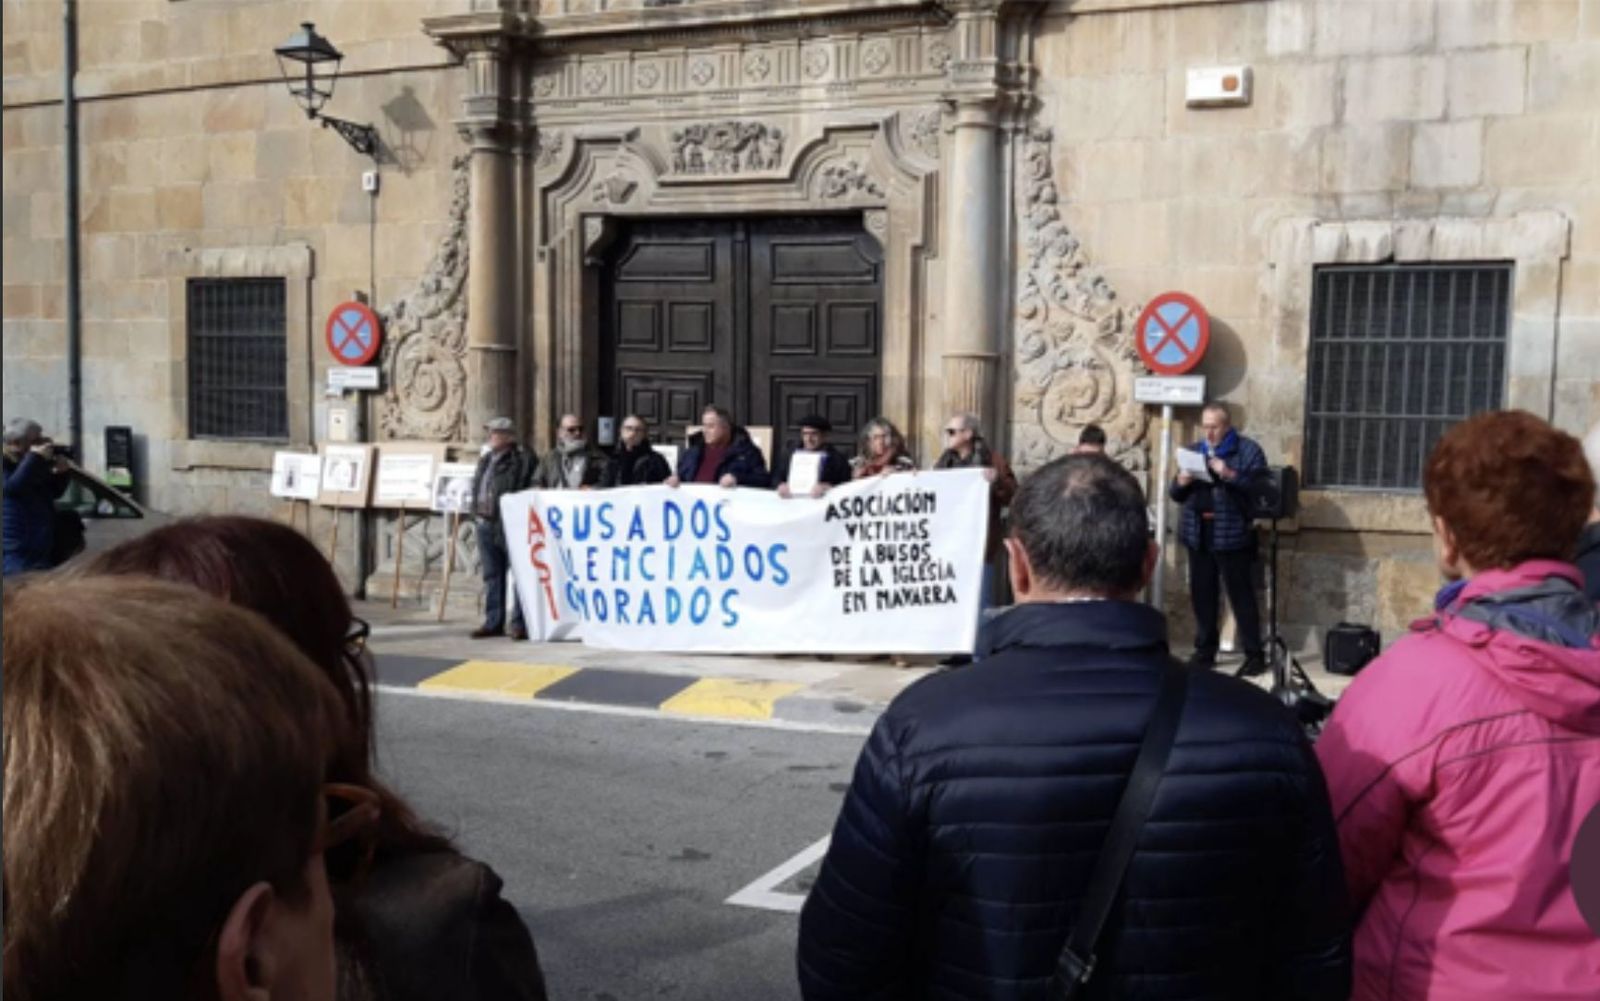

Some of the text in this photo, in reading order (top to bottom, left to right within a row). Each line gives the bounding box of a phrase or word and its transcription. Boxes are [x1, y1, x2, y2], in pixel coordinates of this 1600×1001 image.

[830, 542, 931, 565] DE ABUSOS
[833, 558, 956, 587] DE LA IGLESIA
[843, 584, 957, 614] EN NAVARRA
